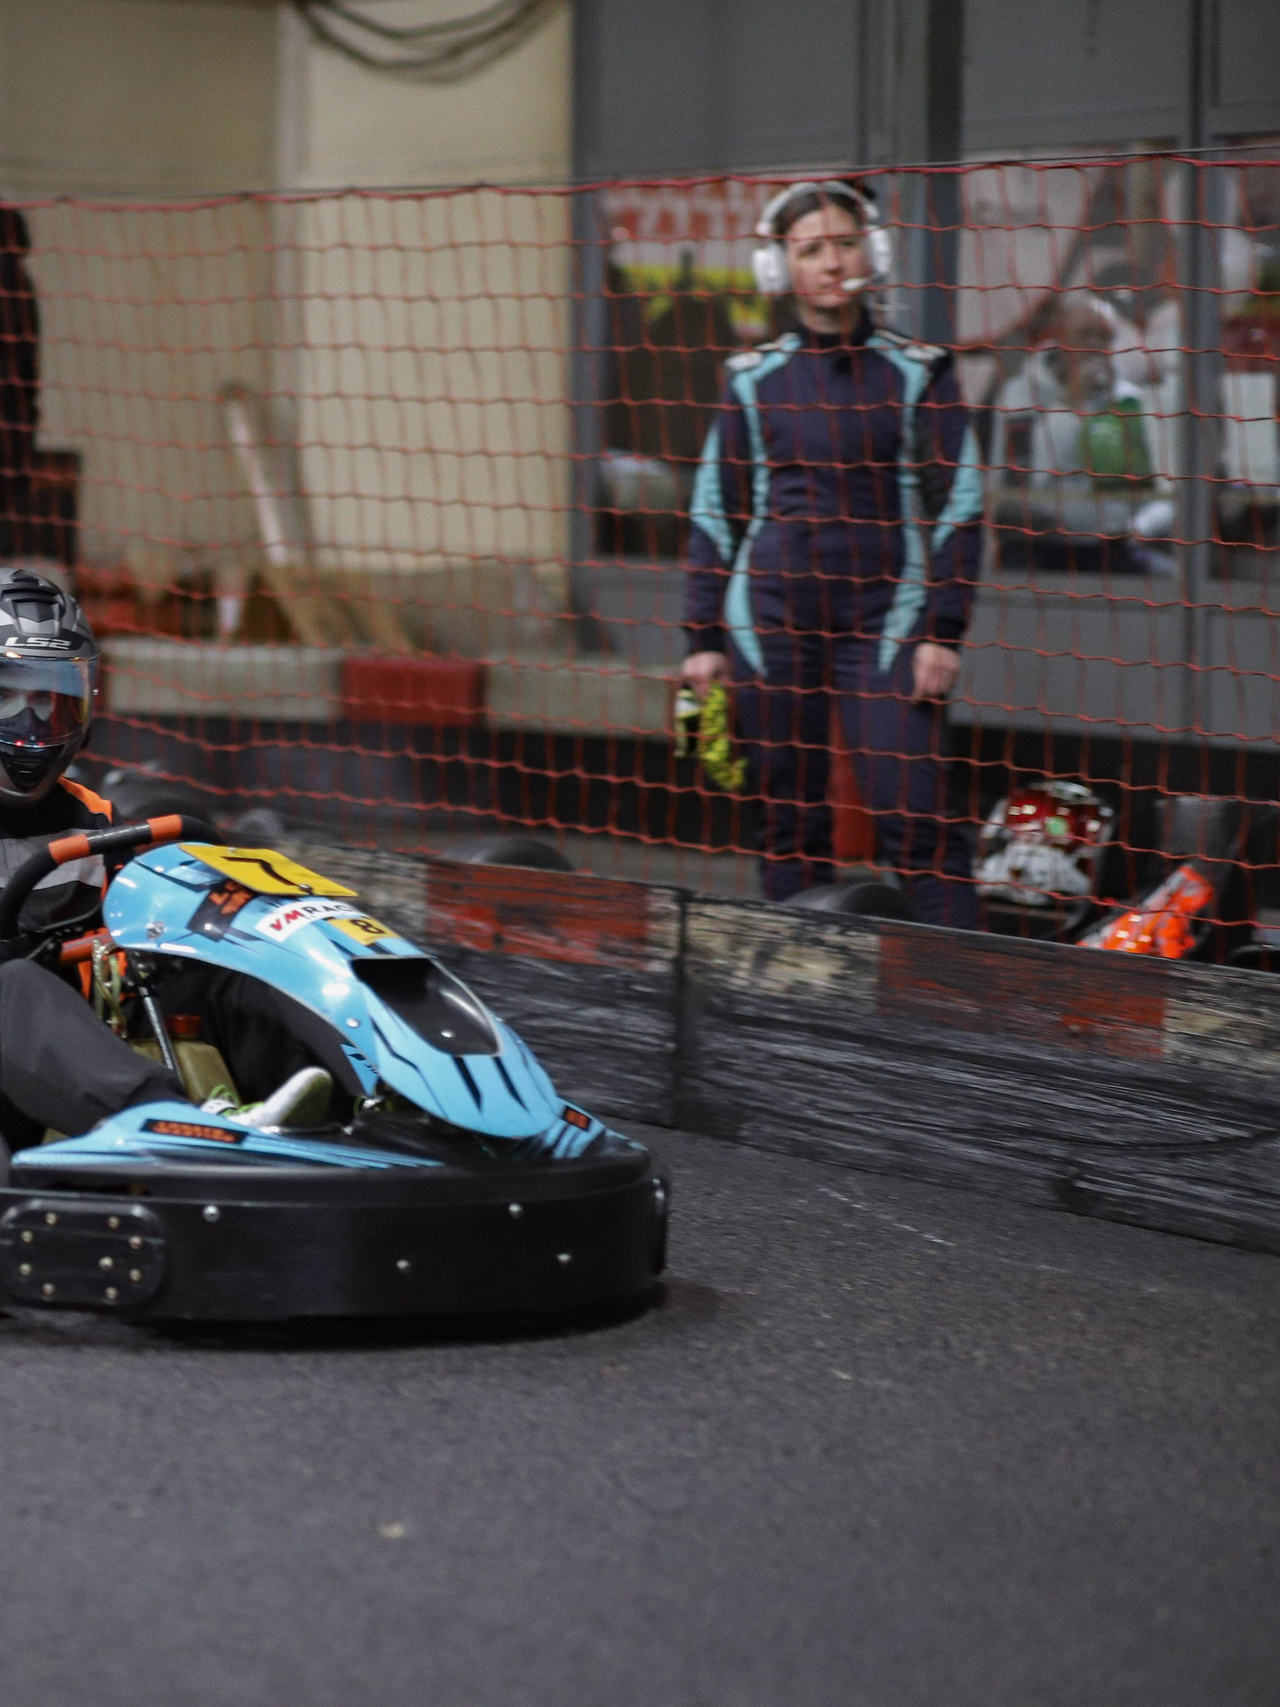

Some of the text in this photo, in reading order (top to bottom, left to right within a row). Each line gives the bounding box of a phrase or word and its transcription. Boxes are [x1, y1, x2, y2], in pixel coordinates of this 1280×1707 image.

[4, 636, 72, 650] LS2
[220, 856, 314, 894] 7
[349, 918, 386, 935] 8
